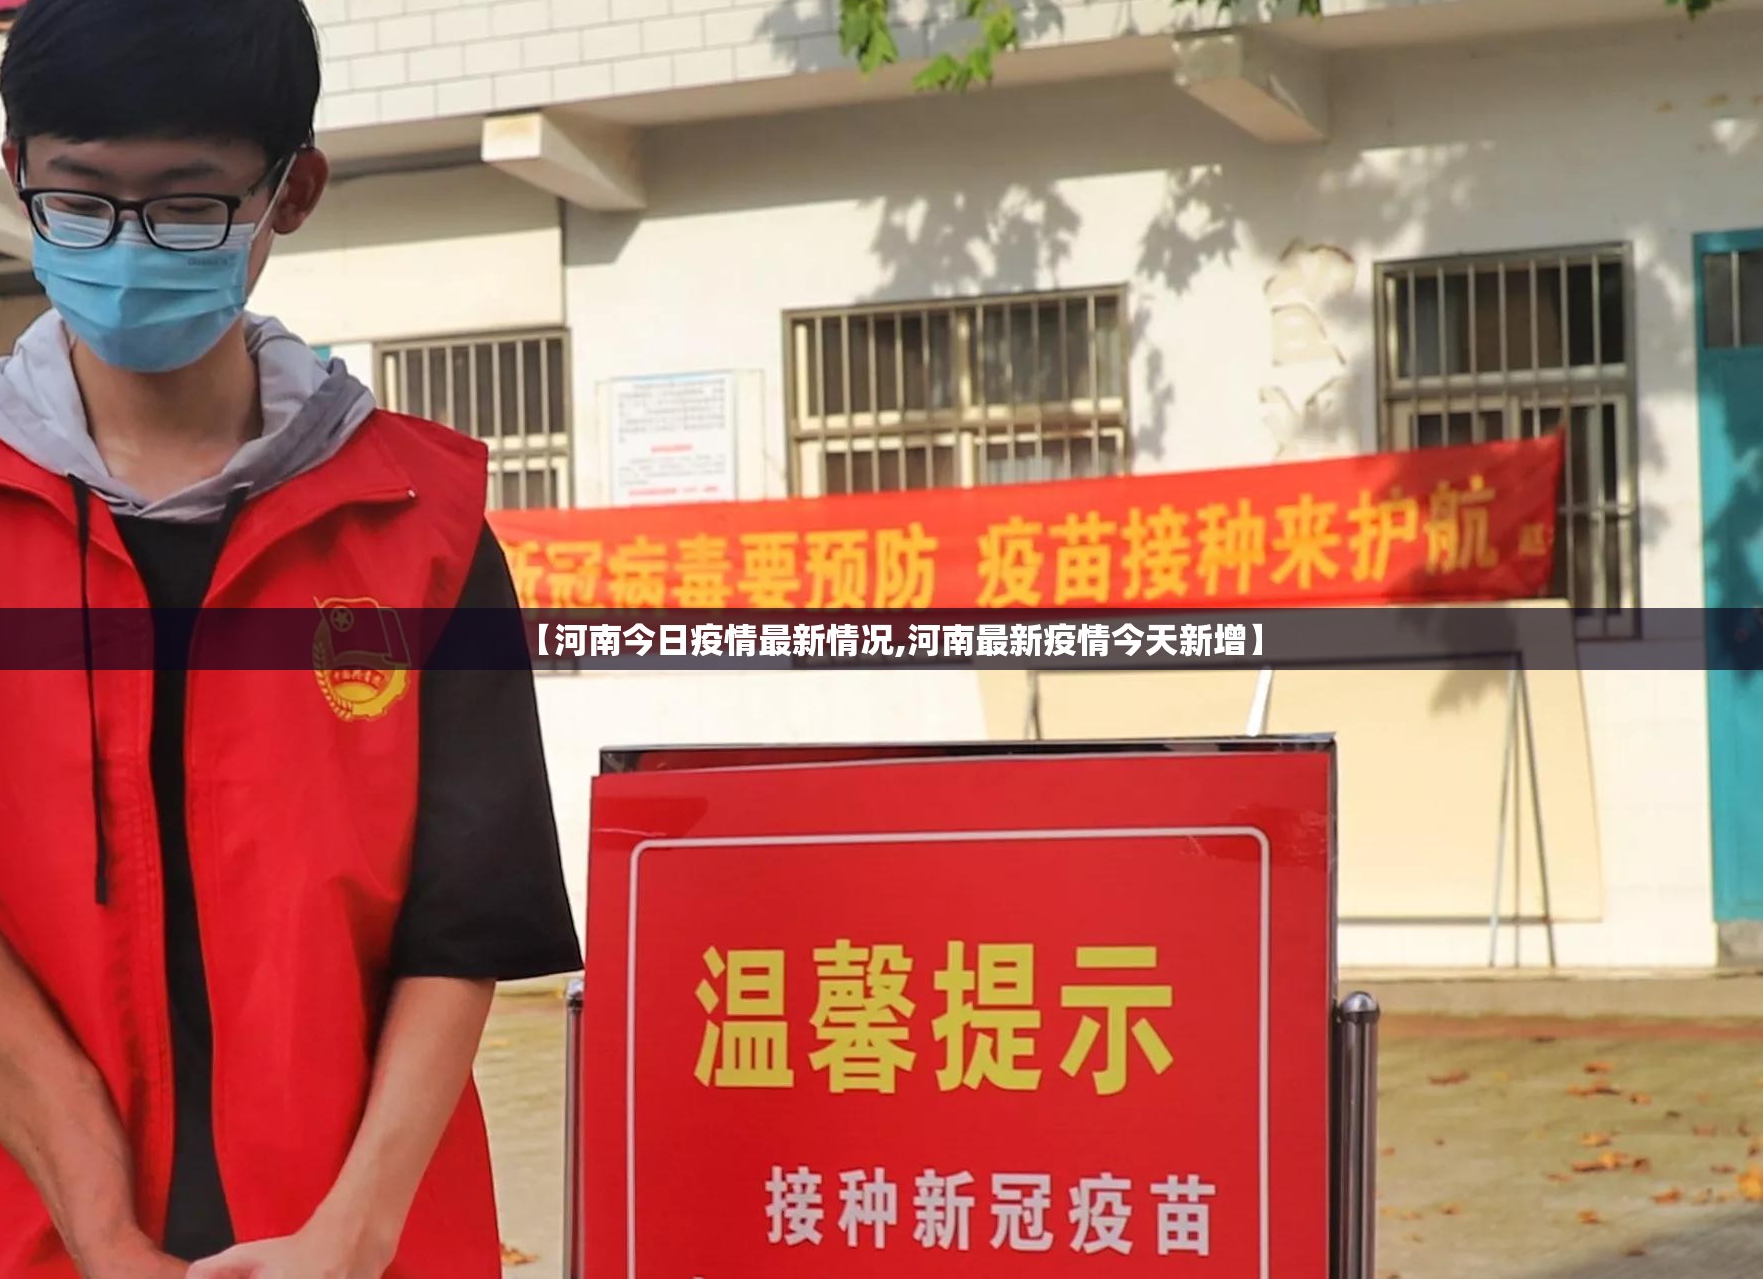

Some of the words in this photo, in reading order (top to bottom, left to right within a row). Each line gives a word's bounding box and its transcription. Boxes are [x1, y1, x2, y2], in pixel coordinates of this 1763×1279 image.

[976, 475, 1498, 608] 疫苗接种来护航
[696, 940, 1173, 1095] 温馨提示
[766, 1167, 1216, 1256] 接种新冠疫苗
